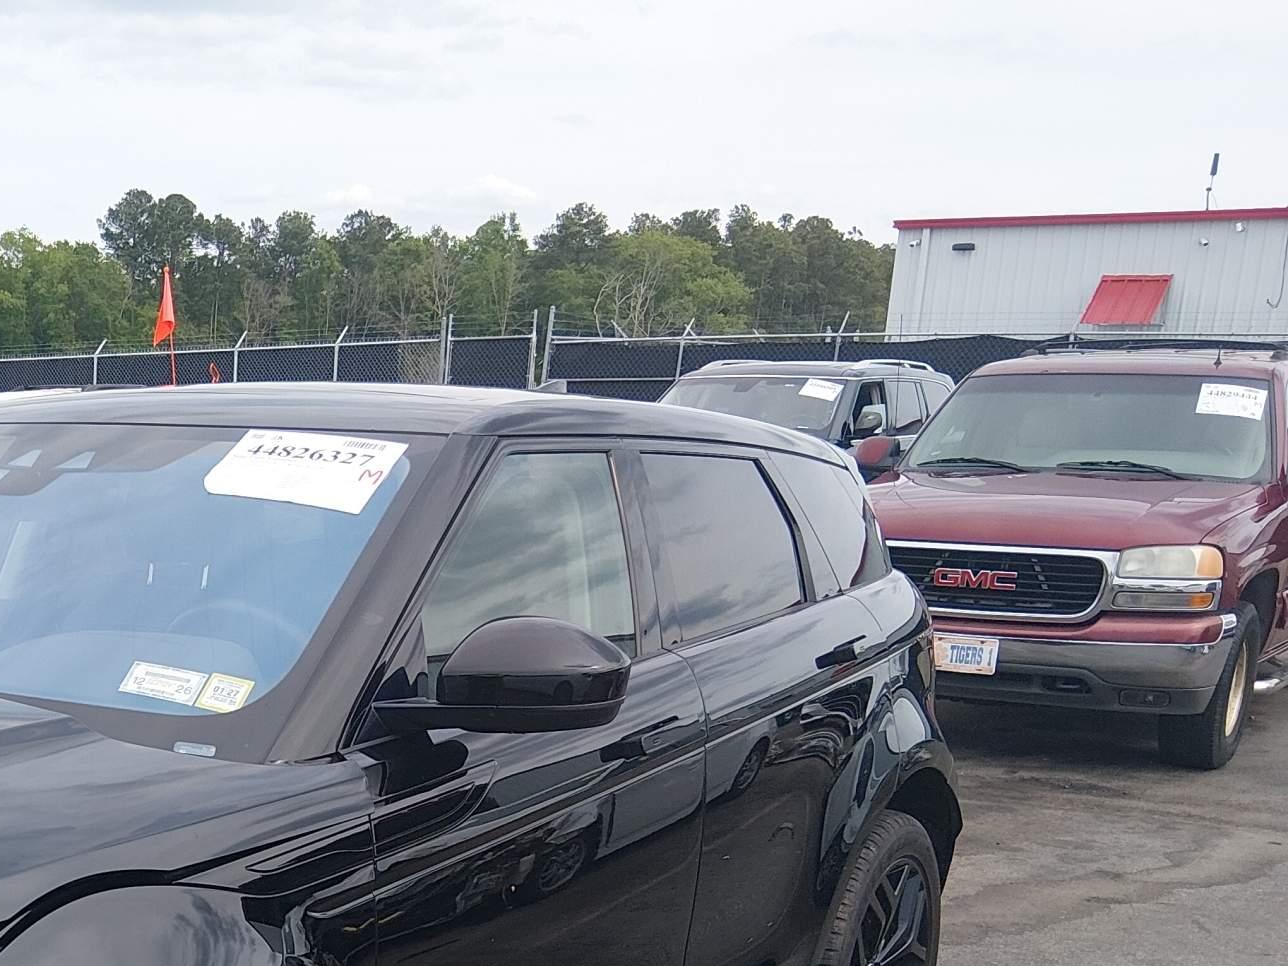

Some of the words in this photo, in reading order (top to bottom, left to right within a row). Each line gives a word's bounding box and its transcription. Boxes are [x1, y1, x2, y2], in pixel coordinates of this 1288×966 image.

[247, 444, 375, 467] 44826327
[358, 469, 383, 485] M
[933, 567, 1018, 591] GMC
[949, 645, 984, 666] TIGERS
[987, 648, 993, 666] 1
[133, 676, 146, 686] 12
[175, 684, 193, 695] 26
